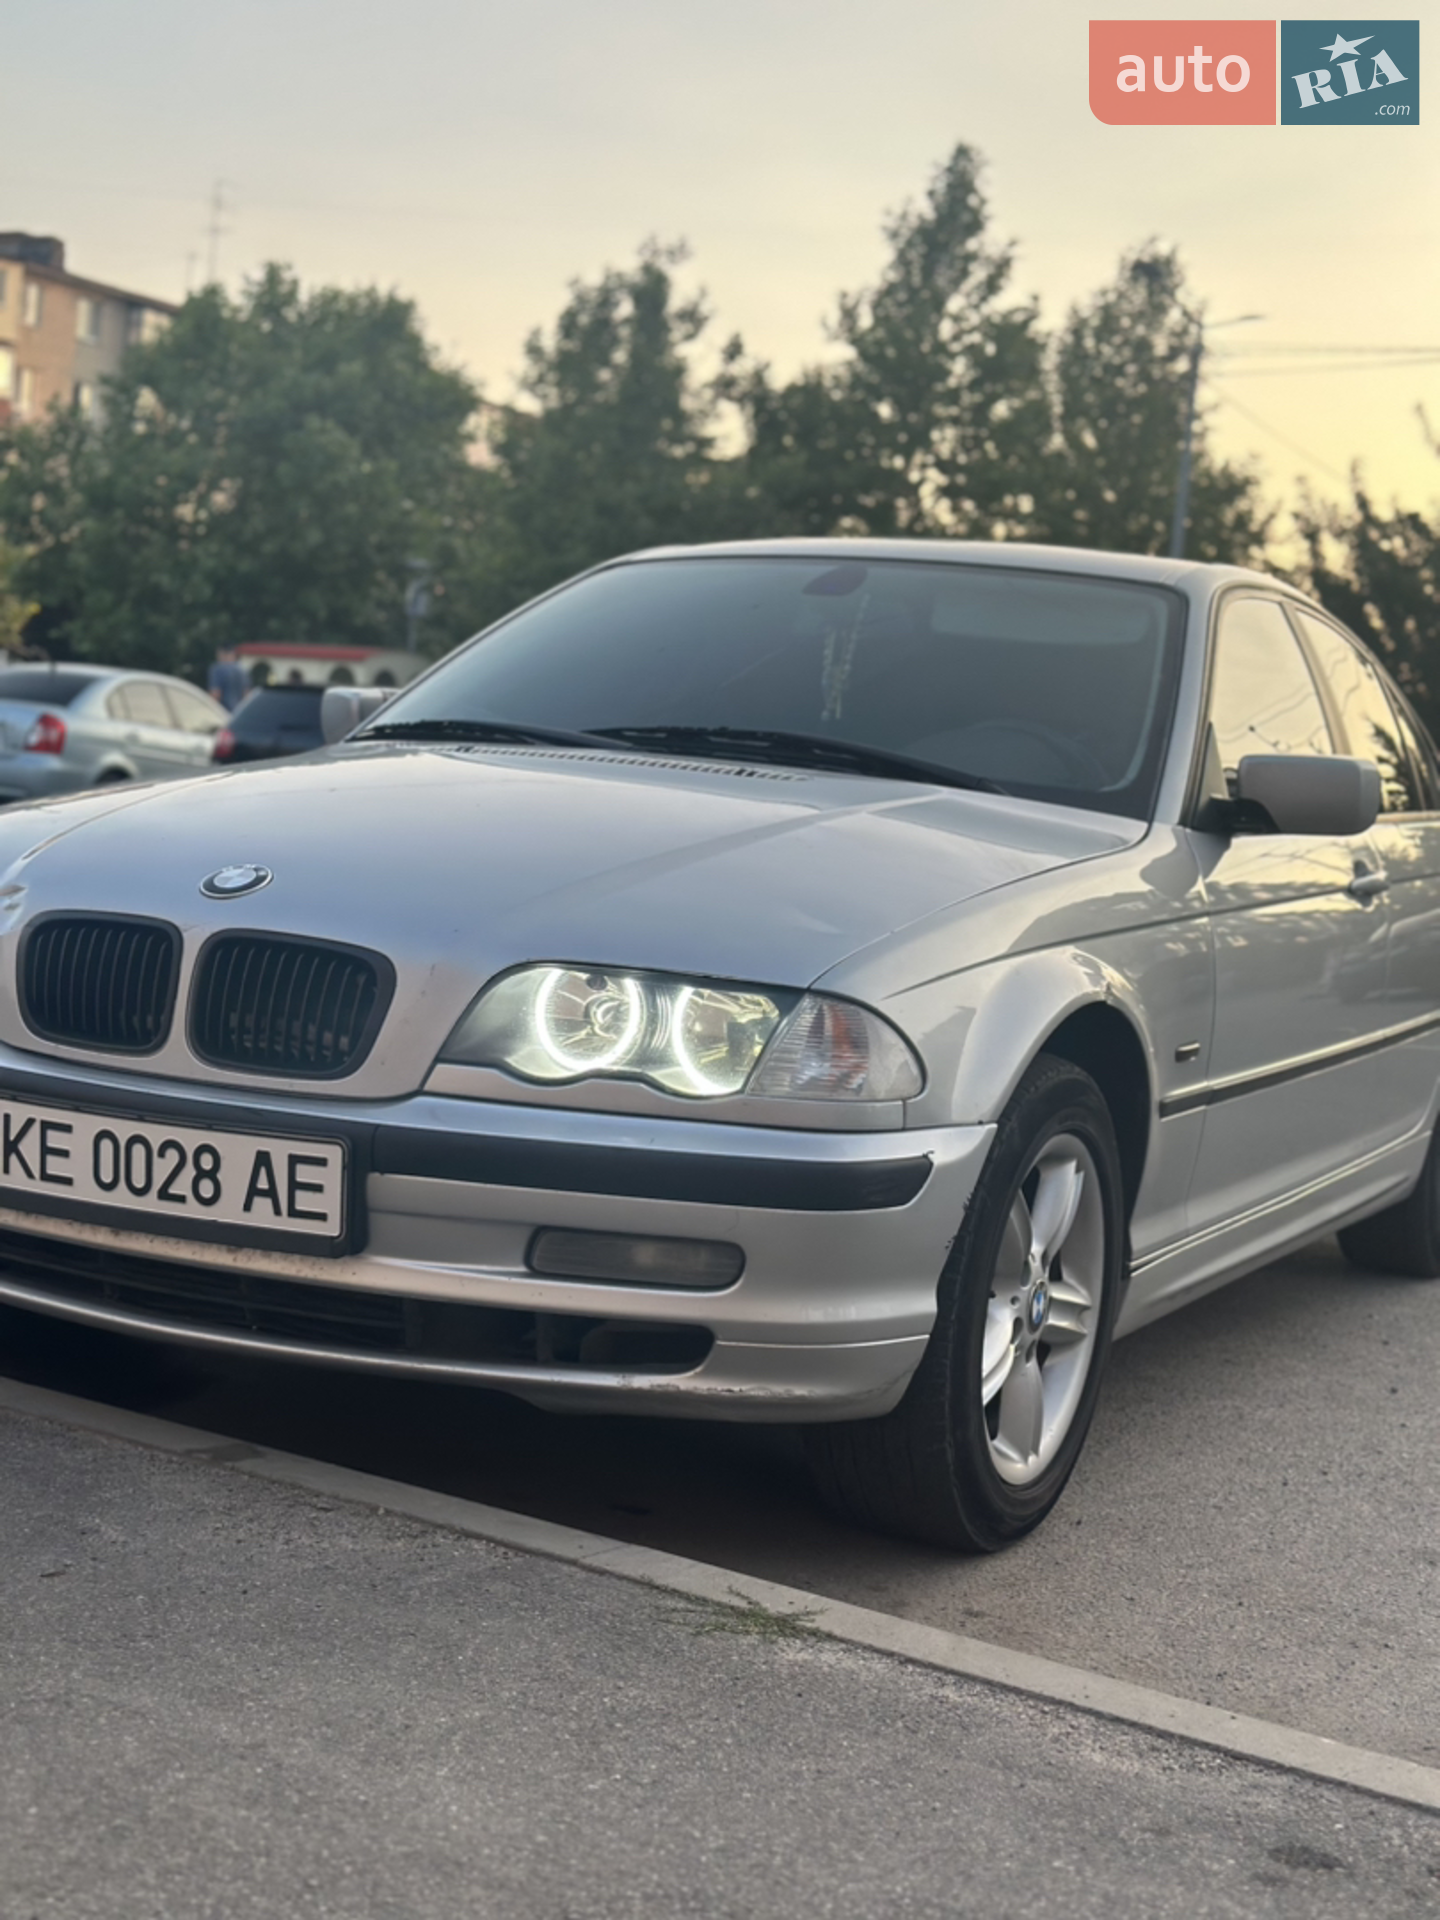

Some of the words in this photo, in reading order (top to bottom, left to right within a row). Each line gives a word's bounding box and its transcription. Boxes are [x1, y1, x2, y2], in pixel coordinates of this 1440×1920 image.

[3, 1113, 74, 1187] KE
[93, 1128, 222, 1207] 0028
[243, 1149, 329, 1222] AE
